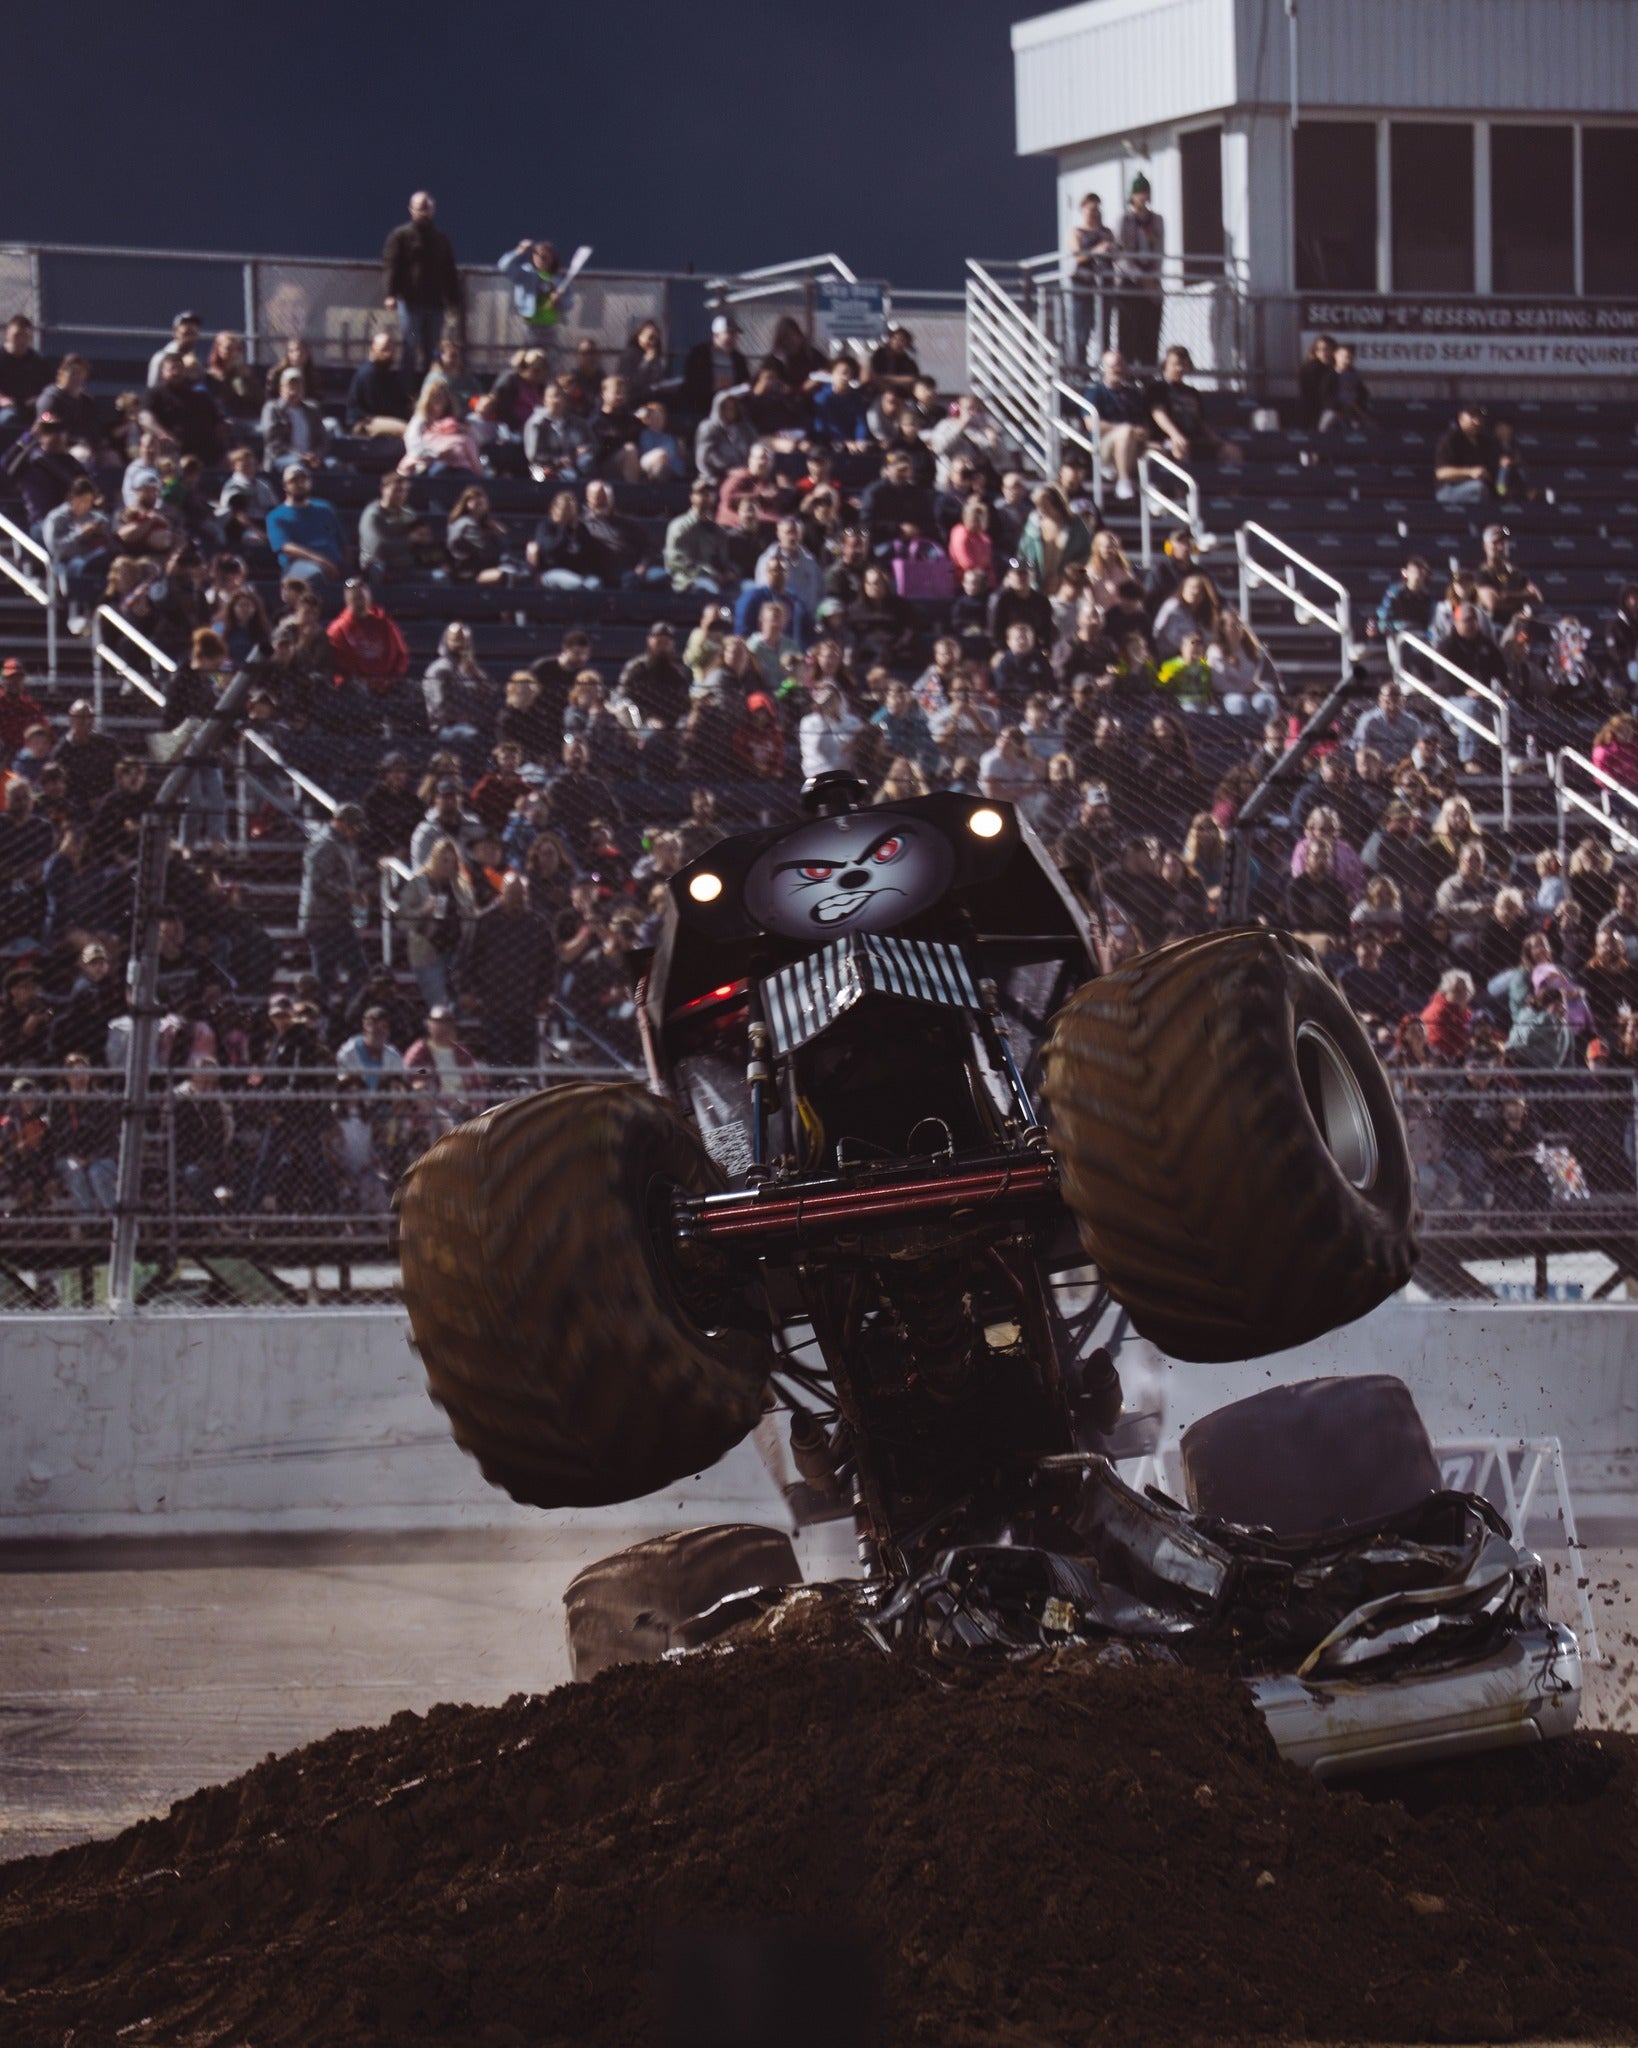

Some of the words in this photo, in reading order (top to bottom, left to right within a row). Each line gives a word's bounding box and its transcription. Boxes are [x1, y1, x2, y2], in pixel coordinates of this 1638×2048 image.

[1308, 303, 1384, 325] SECTION
[1422, 305, 1512, 328] RESERVED
[1353, 343, 1436, 363] ESERVED
[1440, 344, 1482, 363] SEAT
[1488, 344, 1547, 364] TICKET
